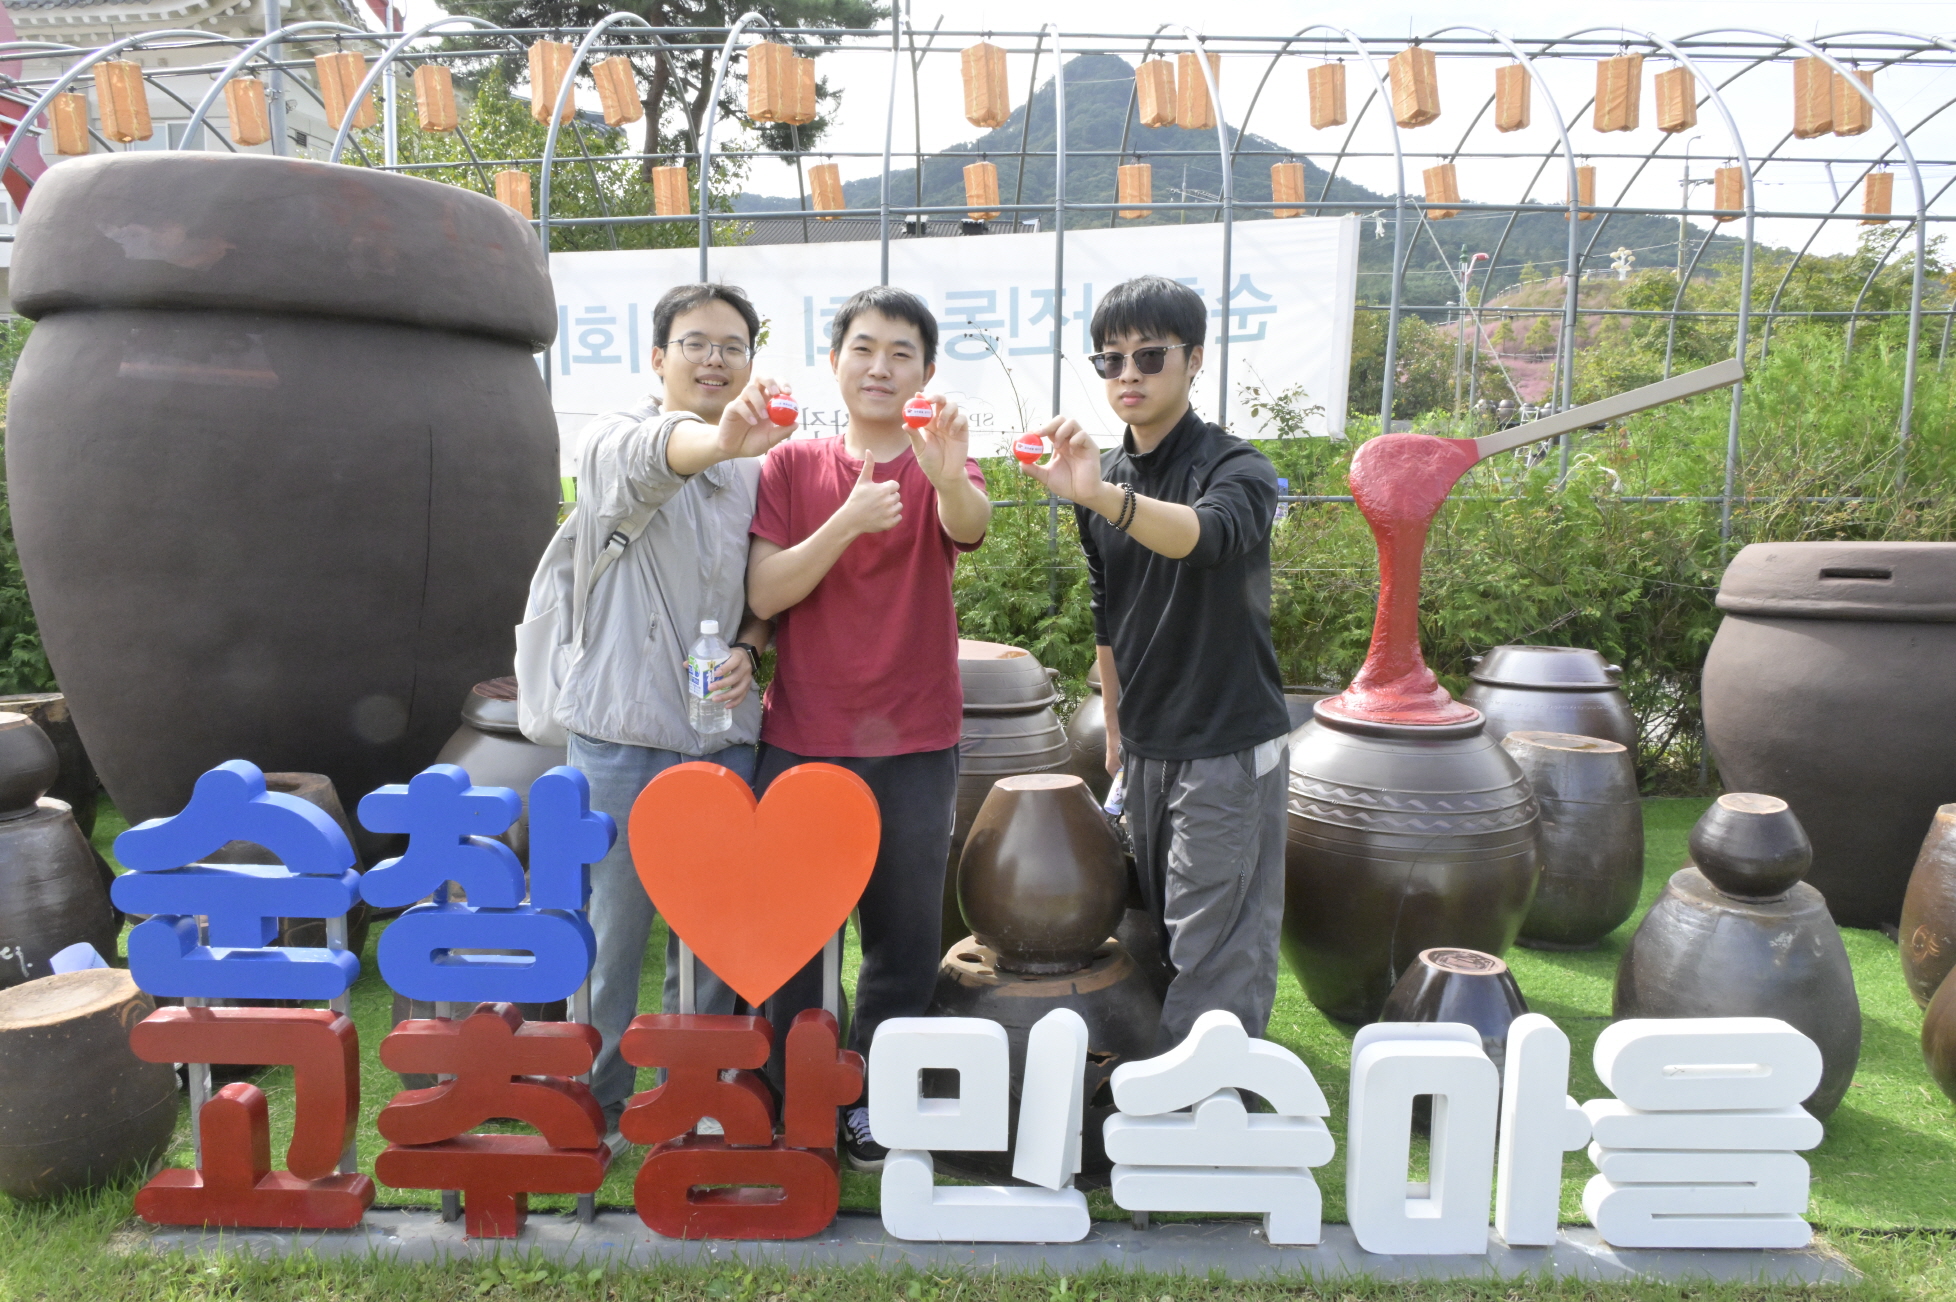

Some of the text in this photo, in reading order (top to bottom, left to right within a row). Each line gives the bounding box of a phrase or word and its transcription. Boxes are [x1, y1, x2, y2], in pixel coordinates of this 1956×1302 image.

[110, 759, 617, 1003] 순창
[130, 1002, 1824, 1255] 고추장 민속마을
